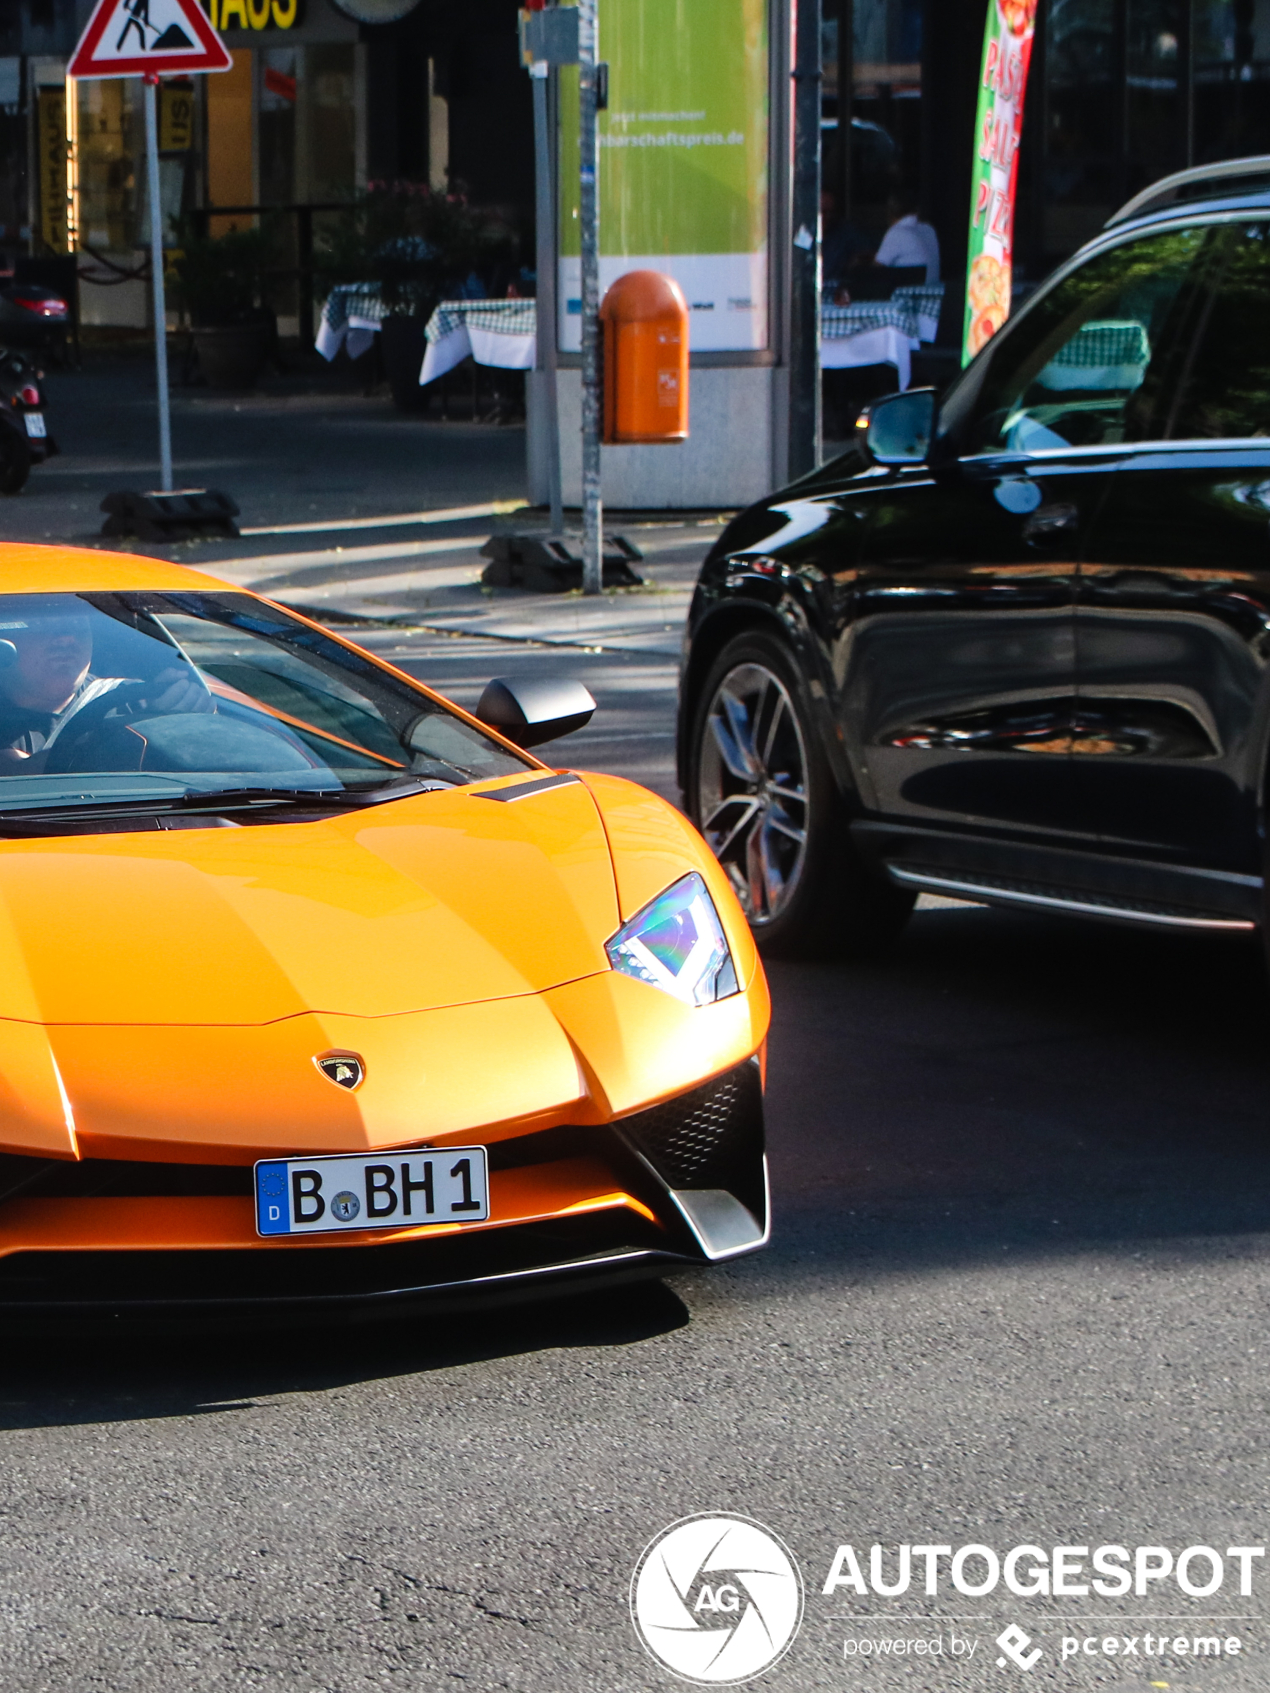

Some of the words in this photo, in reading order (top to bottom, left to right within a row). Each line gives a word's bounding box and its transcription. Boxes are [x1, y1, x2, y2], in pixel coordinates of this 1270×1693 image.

[268, 1205, 280, 1222] D
[291, 1169, 326, 1224] B
[363, 1160, 435, 1218] BH
[450, 1157, 482, 1212] 1
